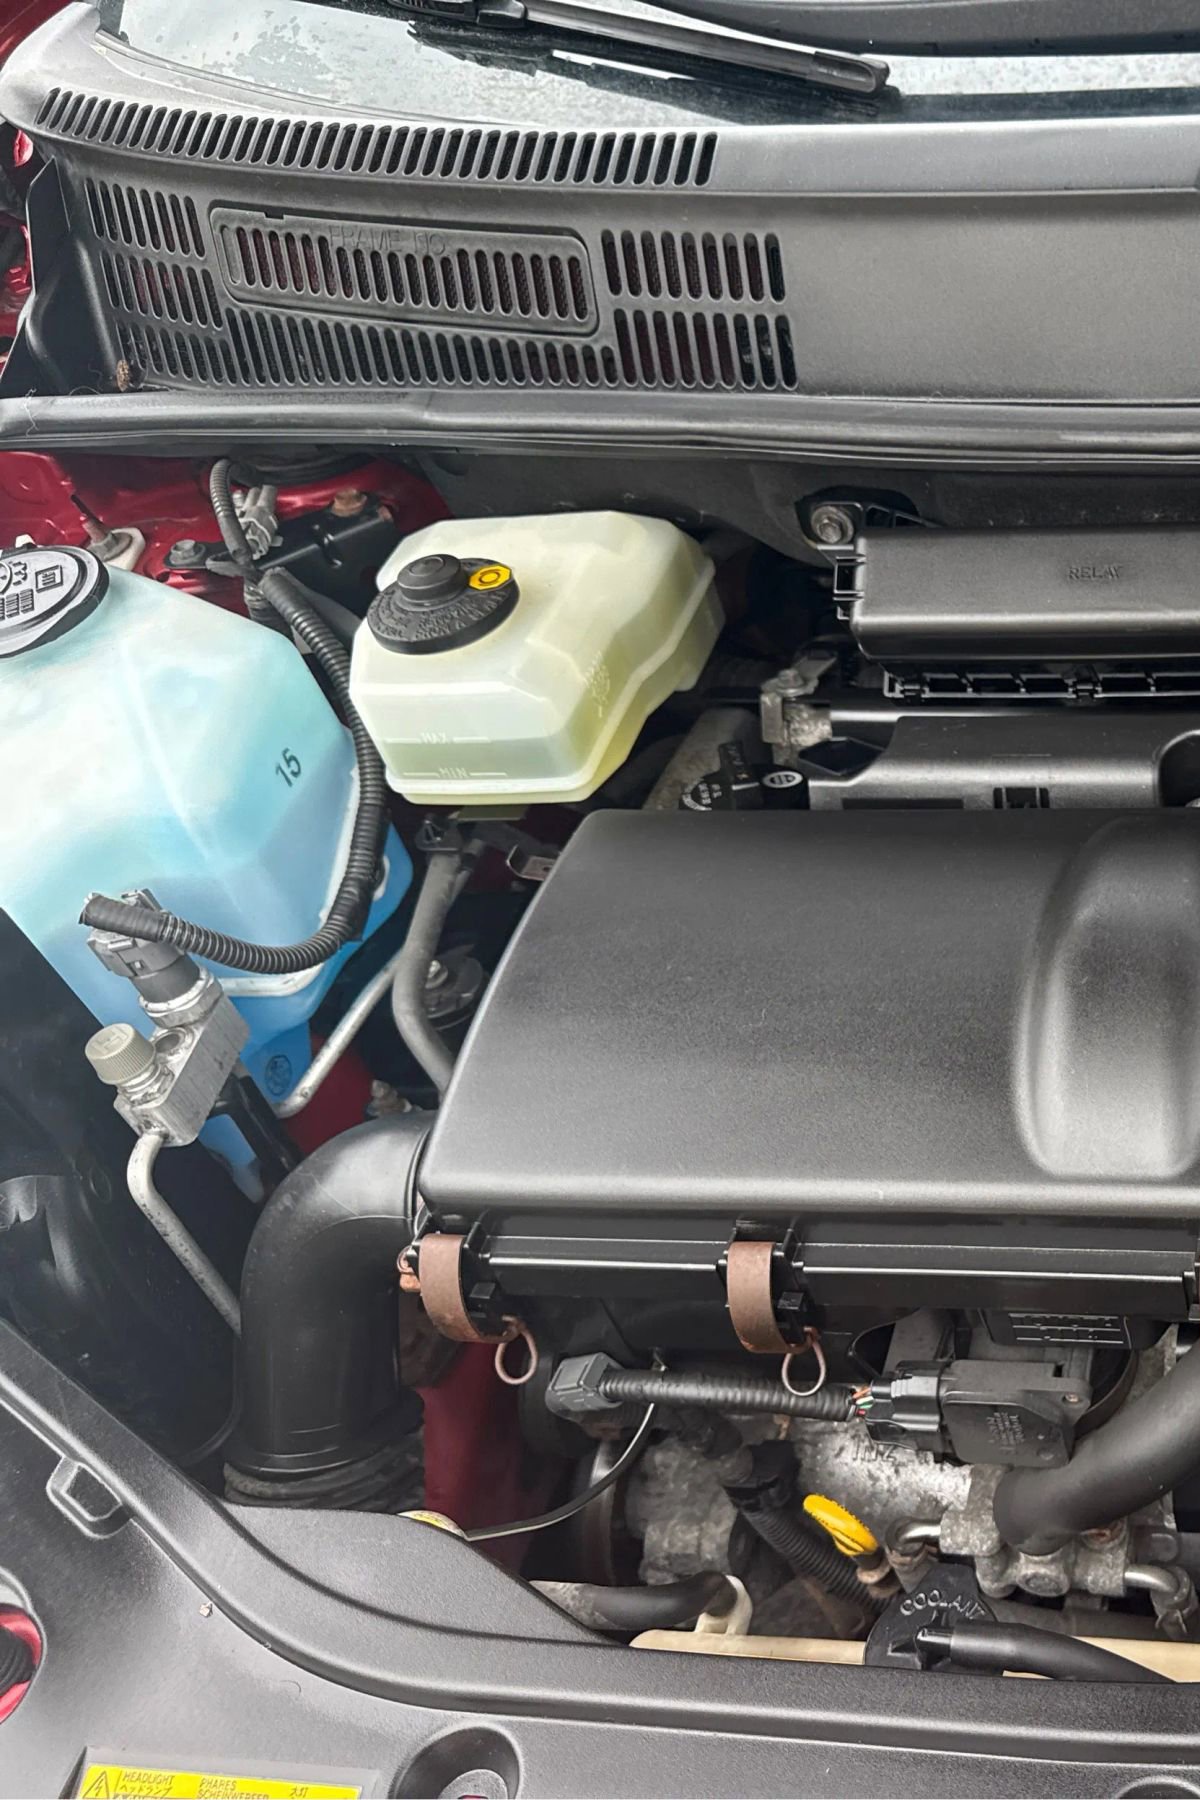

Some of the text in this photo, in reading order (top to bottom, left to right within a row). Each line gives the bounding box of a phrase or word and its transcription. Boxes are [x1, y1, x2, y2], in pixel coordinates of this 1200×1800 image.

[329, 224, 402, 252] FRAME
[1068, 565, 1124, 580] RELAY
[275, 747, 302, 788] 15
[439, 766, 469, 780] MIN
[900, 1588, 986, 1620] COOLANT
[122, 1771, 176, 1786] HEADLIGHT
[199, 1777, 238, 1791] PHARES
